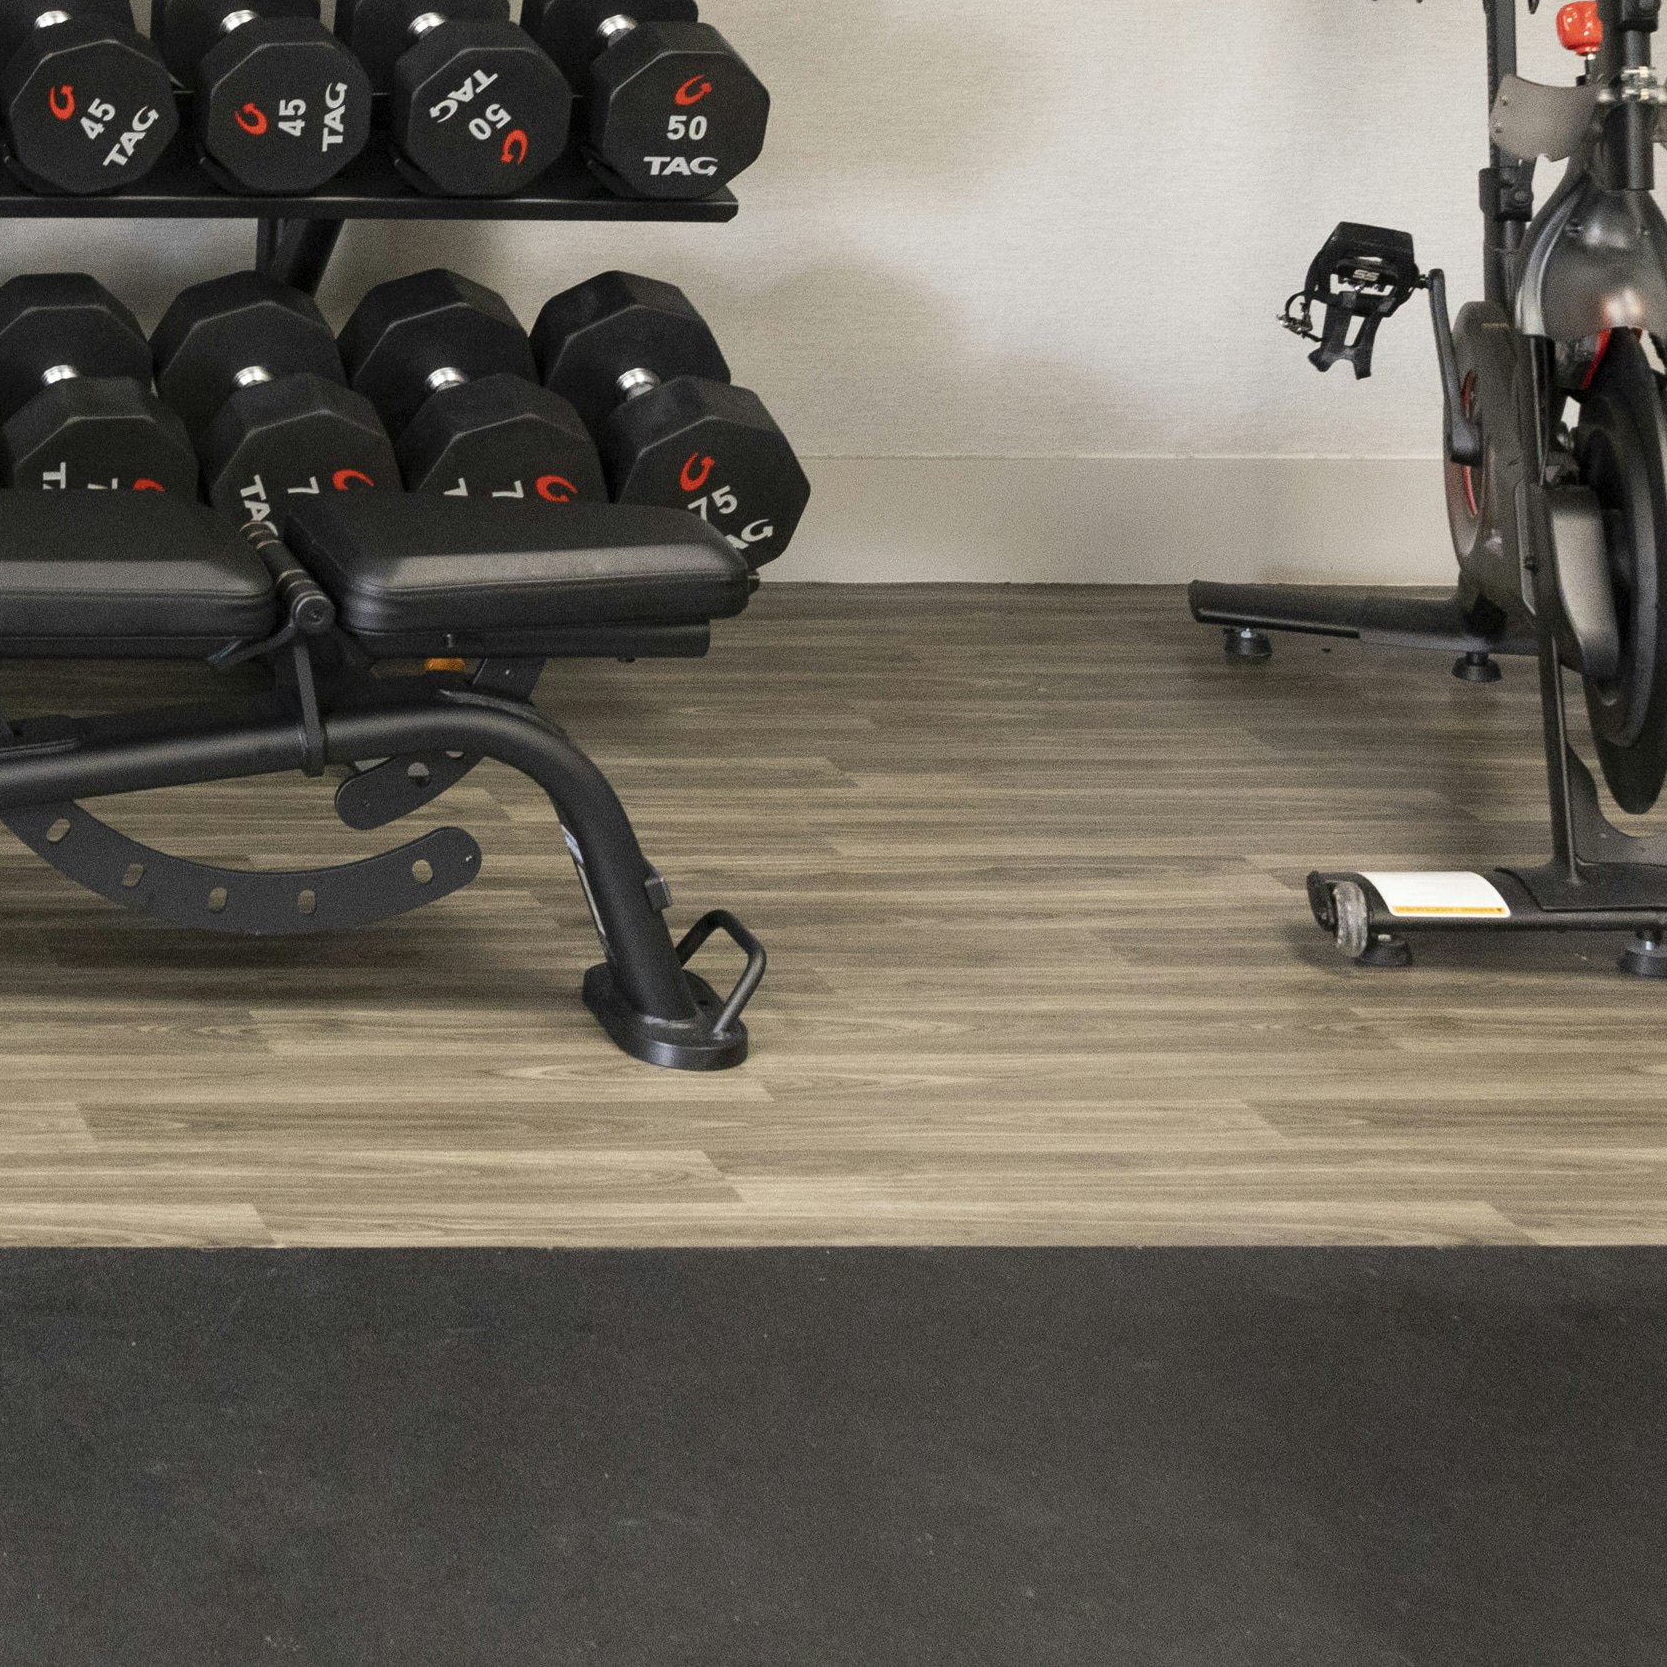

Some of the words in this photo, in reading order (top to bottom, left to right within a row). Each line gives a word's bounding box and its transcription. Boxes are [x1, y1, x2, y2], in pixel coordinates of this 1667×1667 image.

[321, 82, 348, 152] TAG
[429, 69, 500, 126] TAG
[80, 97, 116, 140] 45
[100, 103, 160, 167] TAG
[277, 98, 307, 137] 45
[468, 103, 512, 141] 50
[666, 115, 708, 141] 50
[643, 156, 718, 176] TAG
[687, 485, 738, 522] 75
